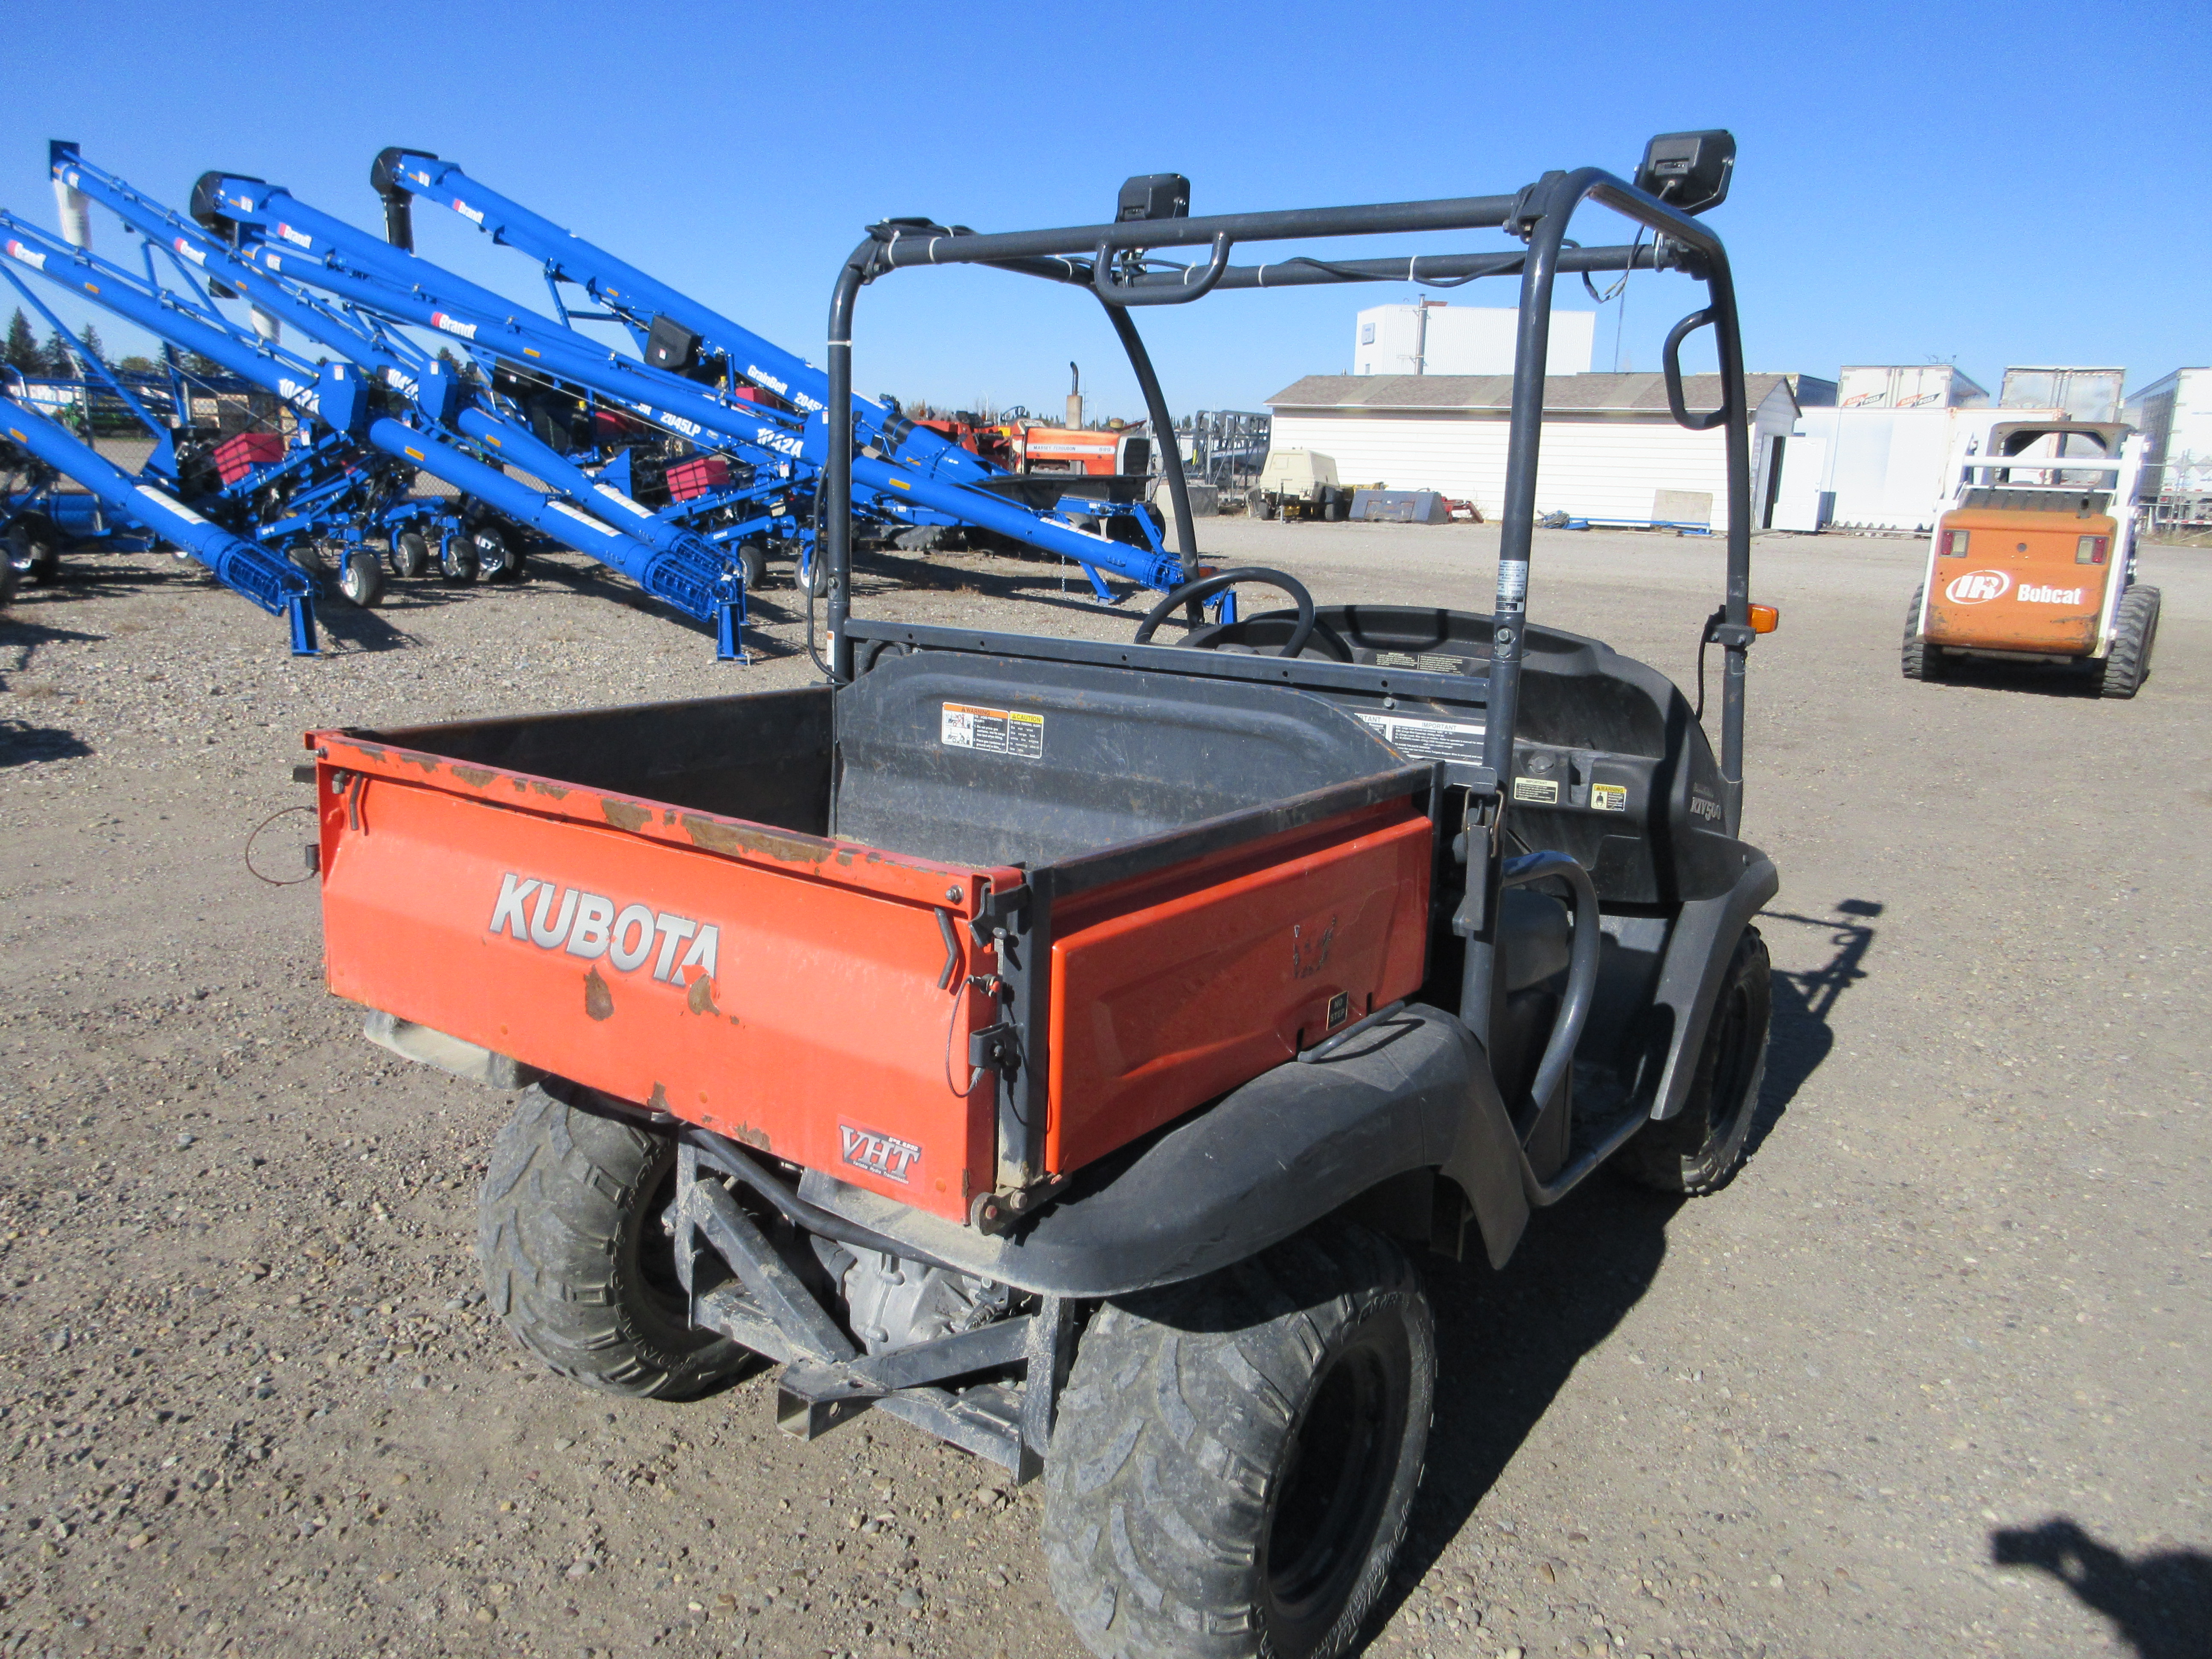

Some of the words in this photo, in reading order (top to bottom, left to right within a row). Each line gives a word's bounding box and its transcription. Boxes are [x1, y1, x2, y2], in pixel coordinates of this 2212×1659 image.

[439, 314, 478, 341] Brandt
[748, 365, 788, 396] GrainBelt
[2017, 584, 2081, 605] Bobcat
[1016, 714, 1041, 722] CAUTION
[1421, 722, 1457, 731] IMPORTANT
[489, 872, 719, 987] KUBOTA
[1334, 997, 1343, 1009] NO
[1330, 1008, 1345, 1021] STEP
[839, 1124, 921, 1179] VHT
[889, 1137, 918, 1151] PLUS
[853, 1160, 868, 1170] Variable
[883, 1171, 909, 1185] Transmission
